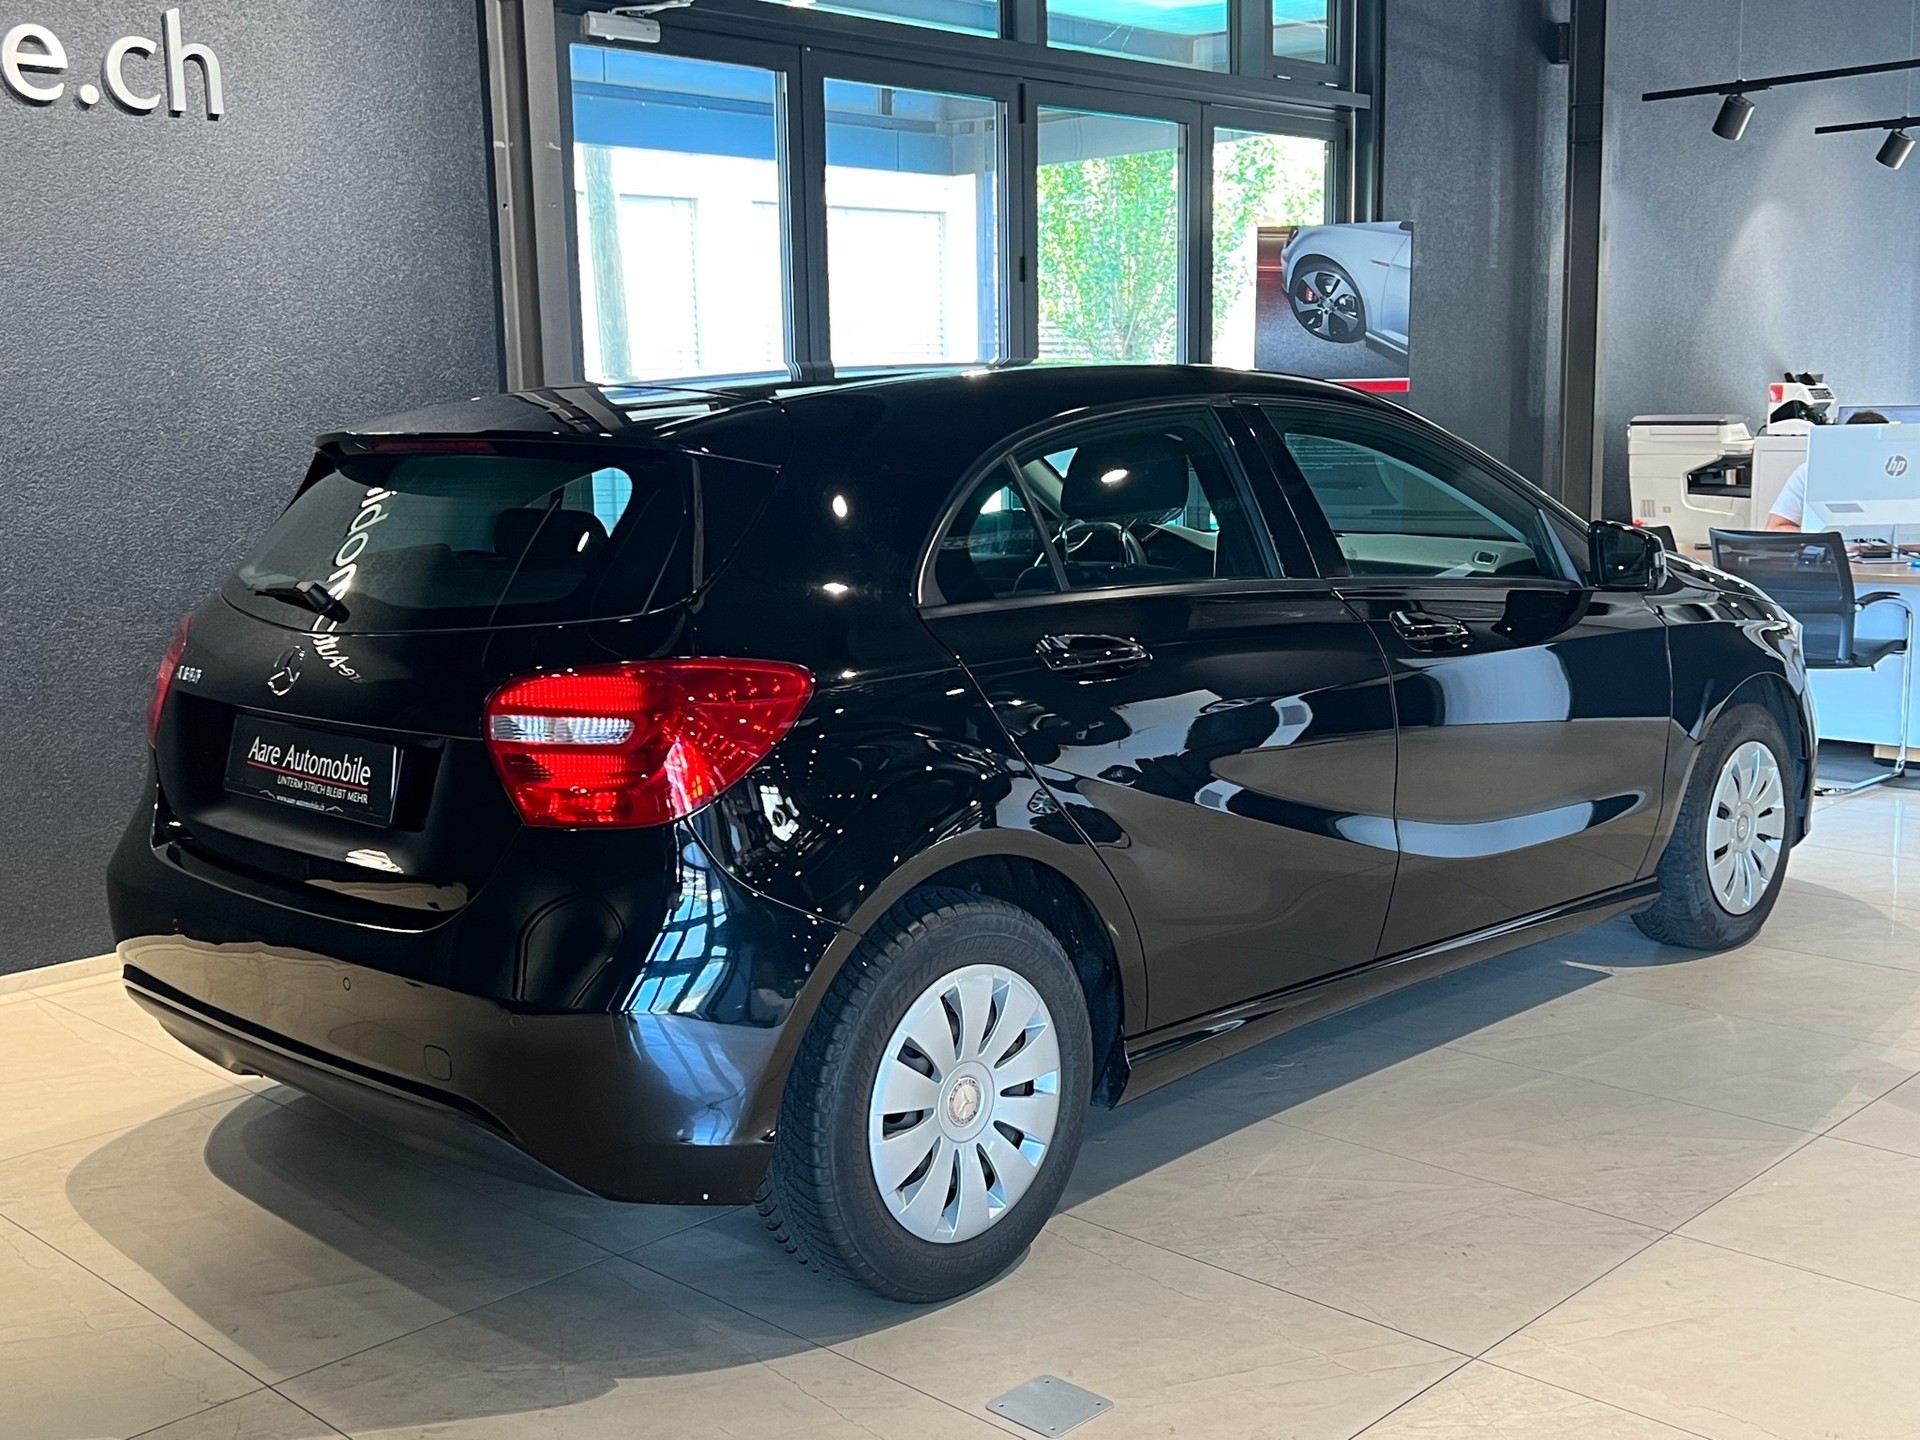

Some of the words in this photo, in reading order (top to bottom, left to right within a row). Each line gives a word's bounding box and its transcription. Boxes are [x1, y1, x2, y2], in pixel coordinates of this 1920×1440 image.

[1886, 455, 1907, 477] hp
[248, 735, 281, 765] Aare
[282, 744, 371, 785] Automobile
[277, 775, 303, 789] UNTERM
[303, 781, 326, 795] STRICH
[326, 785, 346, 799] BLEIBT
[347, 791, 368, 804] MEHR
